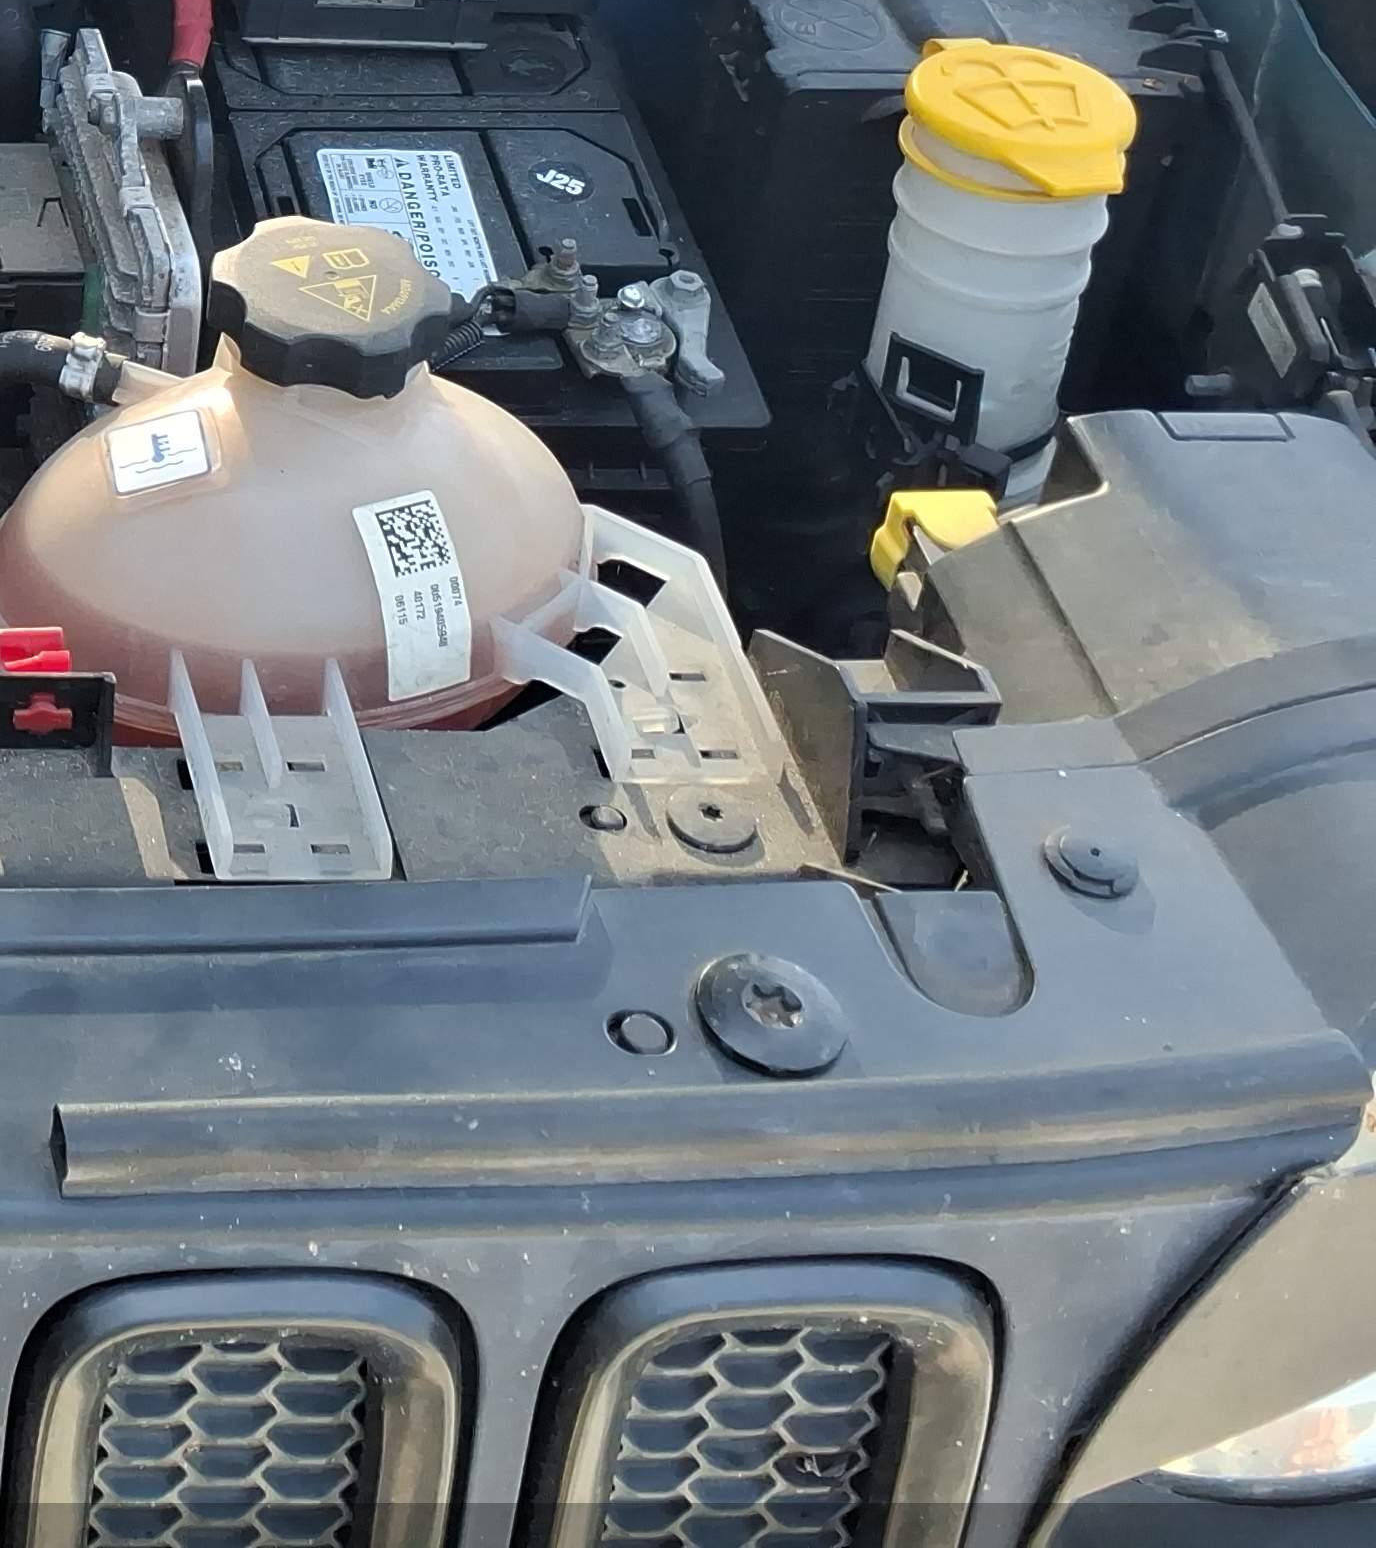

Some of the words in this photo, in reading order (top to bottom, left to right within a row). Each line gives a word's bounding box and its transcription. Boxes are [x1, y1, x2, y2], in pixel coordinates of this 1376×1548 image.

[416, 155, 438, 202] WARRANTY
[430, 155, 450, 196] PRO-RATA
[444, 155, 461, 189] LIMITED
[536, 169, 586, 195] J25
[414, 591, 426, 620] 40172
[449, 576, 463, 606] 00074
[395, 595, 408, 625] 06115
